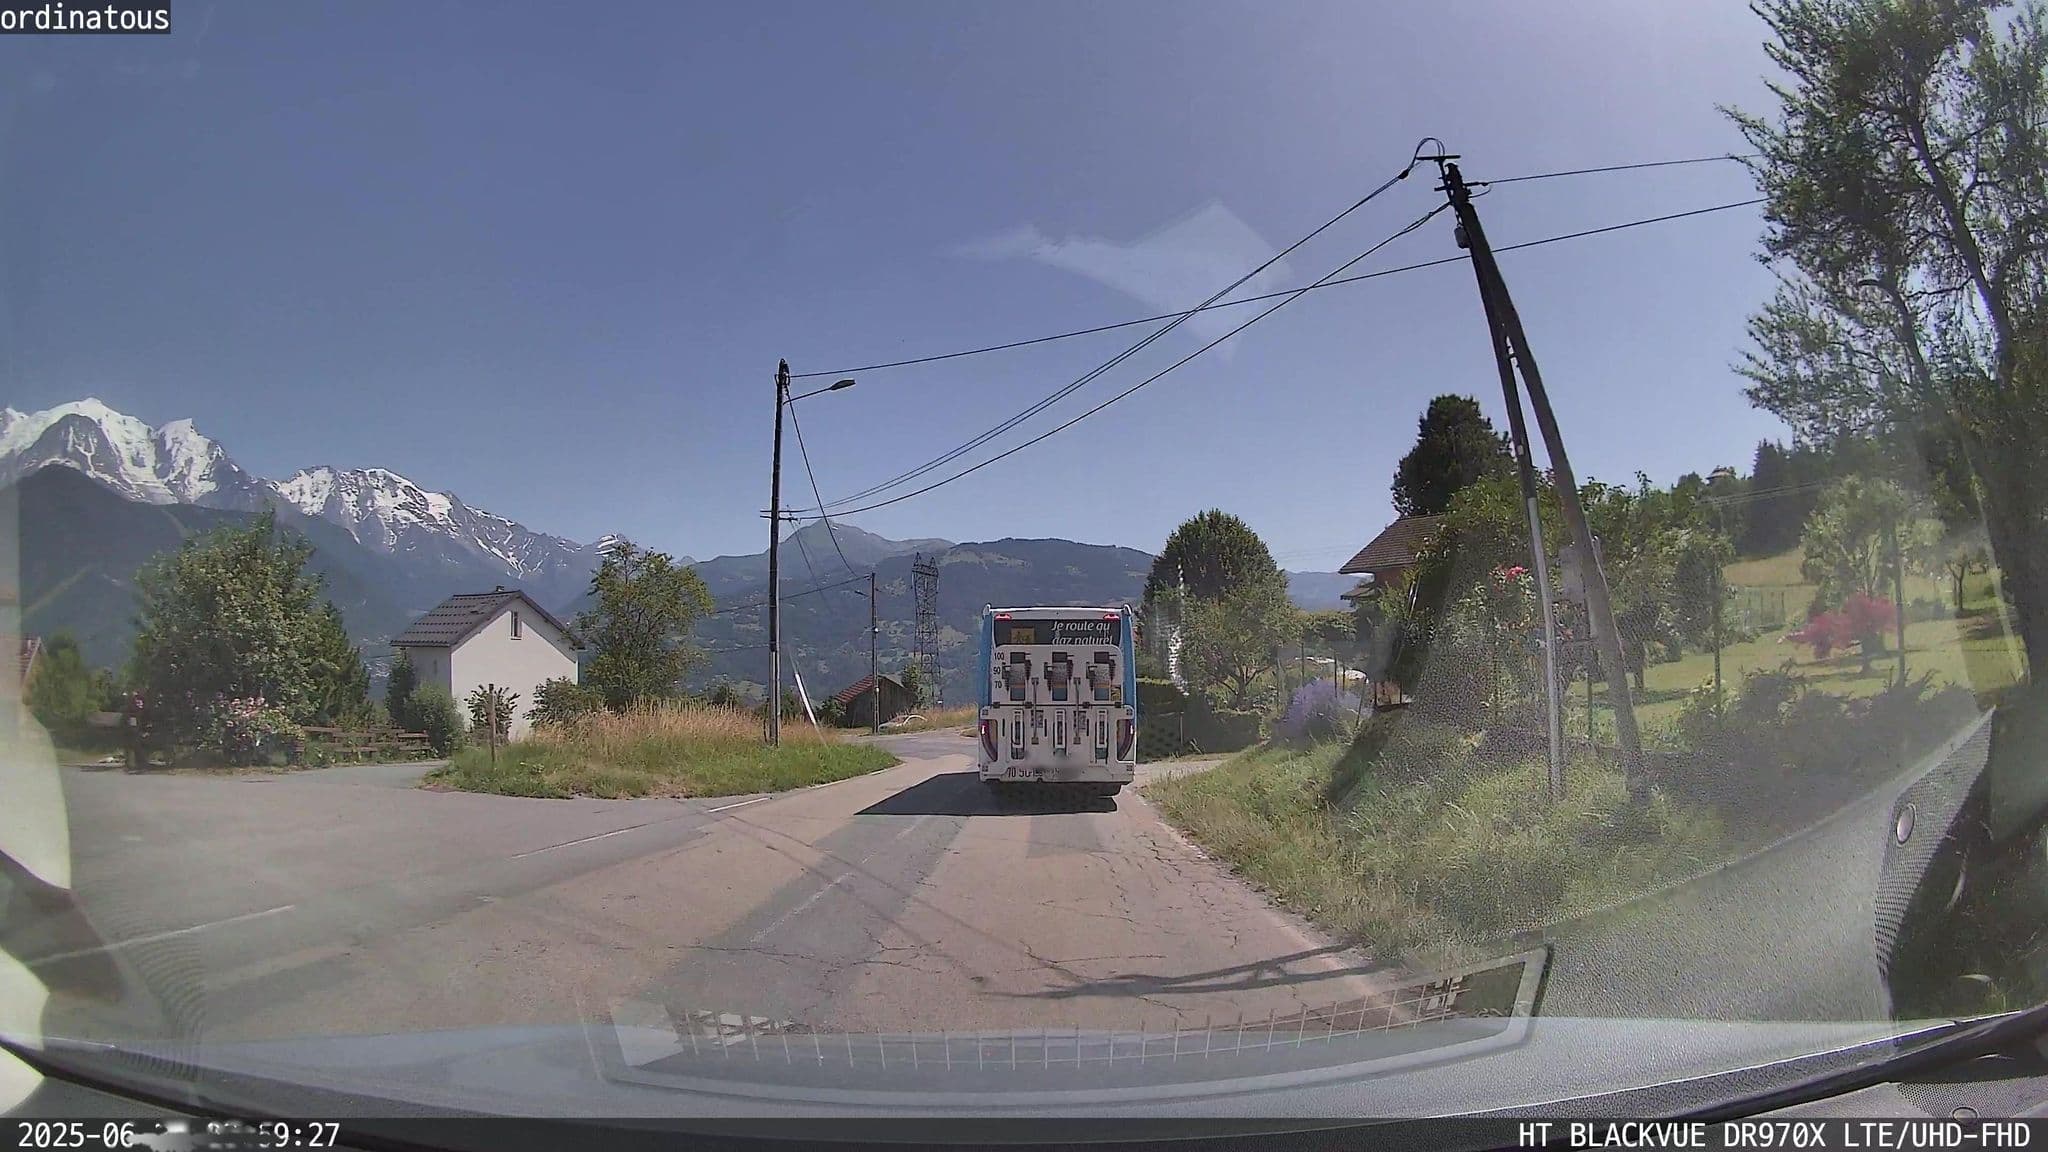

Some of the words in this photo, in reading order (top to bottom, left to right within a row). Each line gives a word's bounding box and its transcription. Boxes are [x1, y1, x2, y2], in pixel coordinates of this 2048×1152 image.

[1051, 621, 1064, 631] Je
[1066, 621, 1094, 631] roule
[994, 652, 1005, 661] 100
